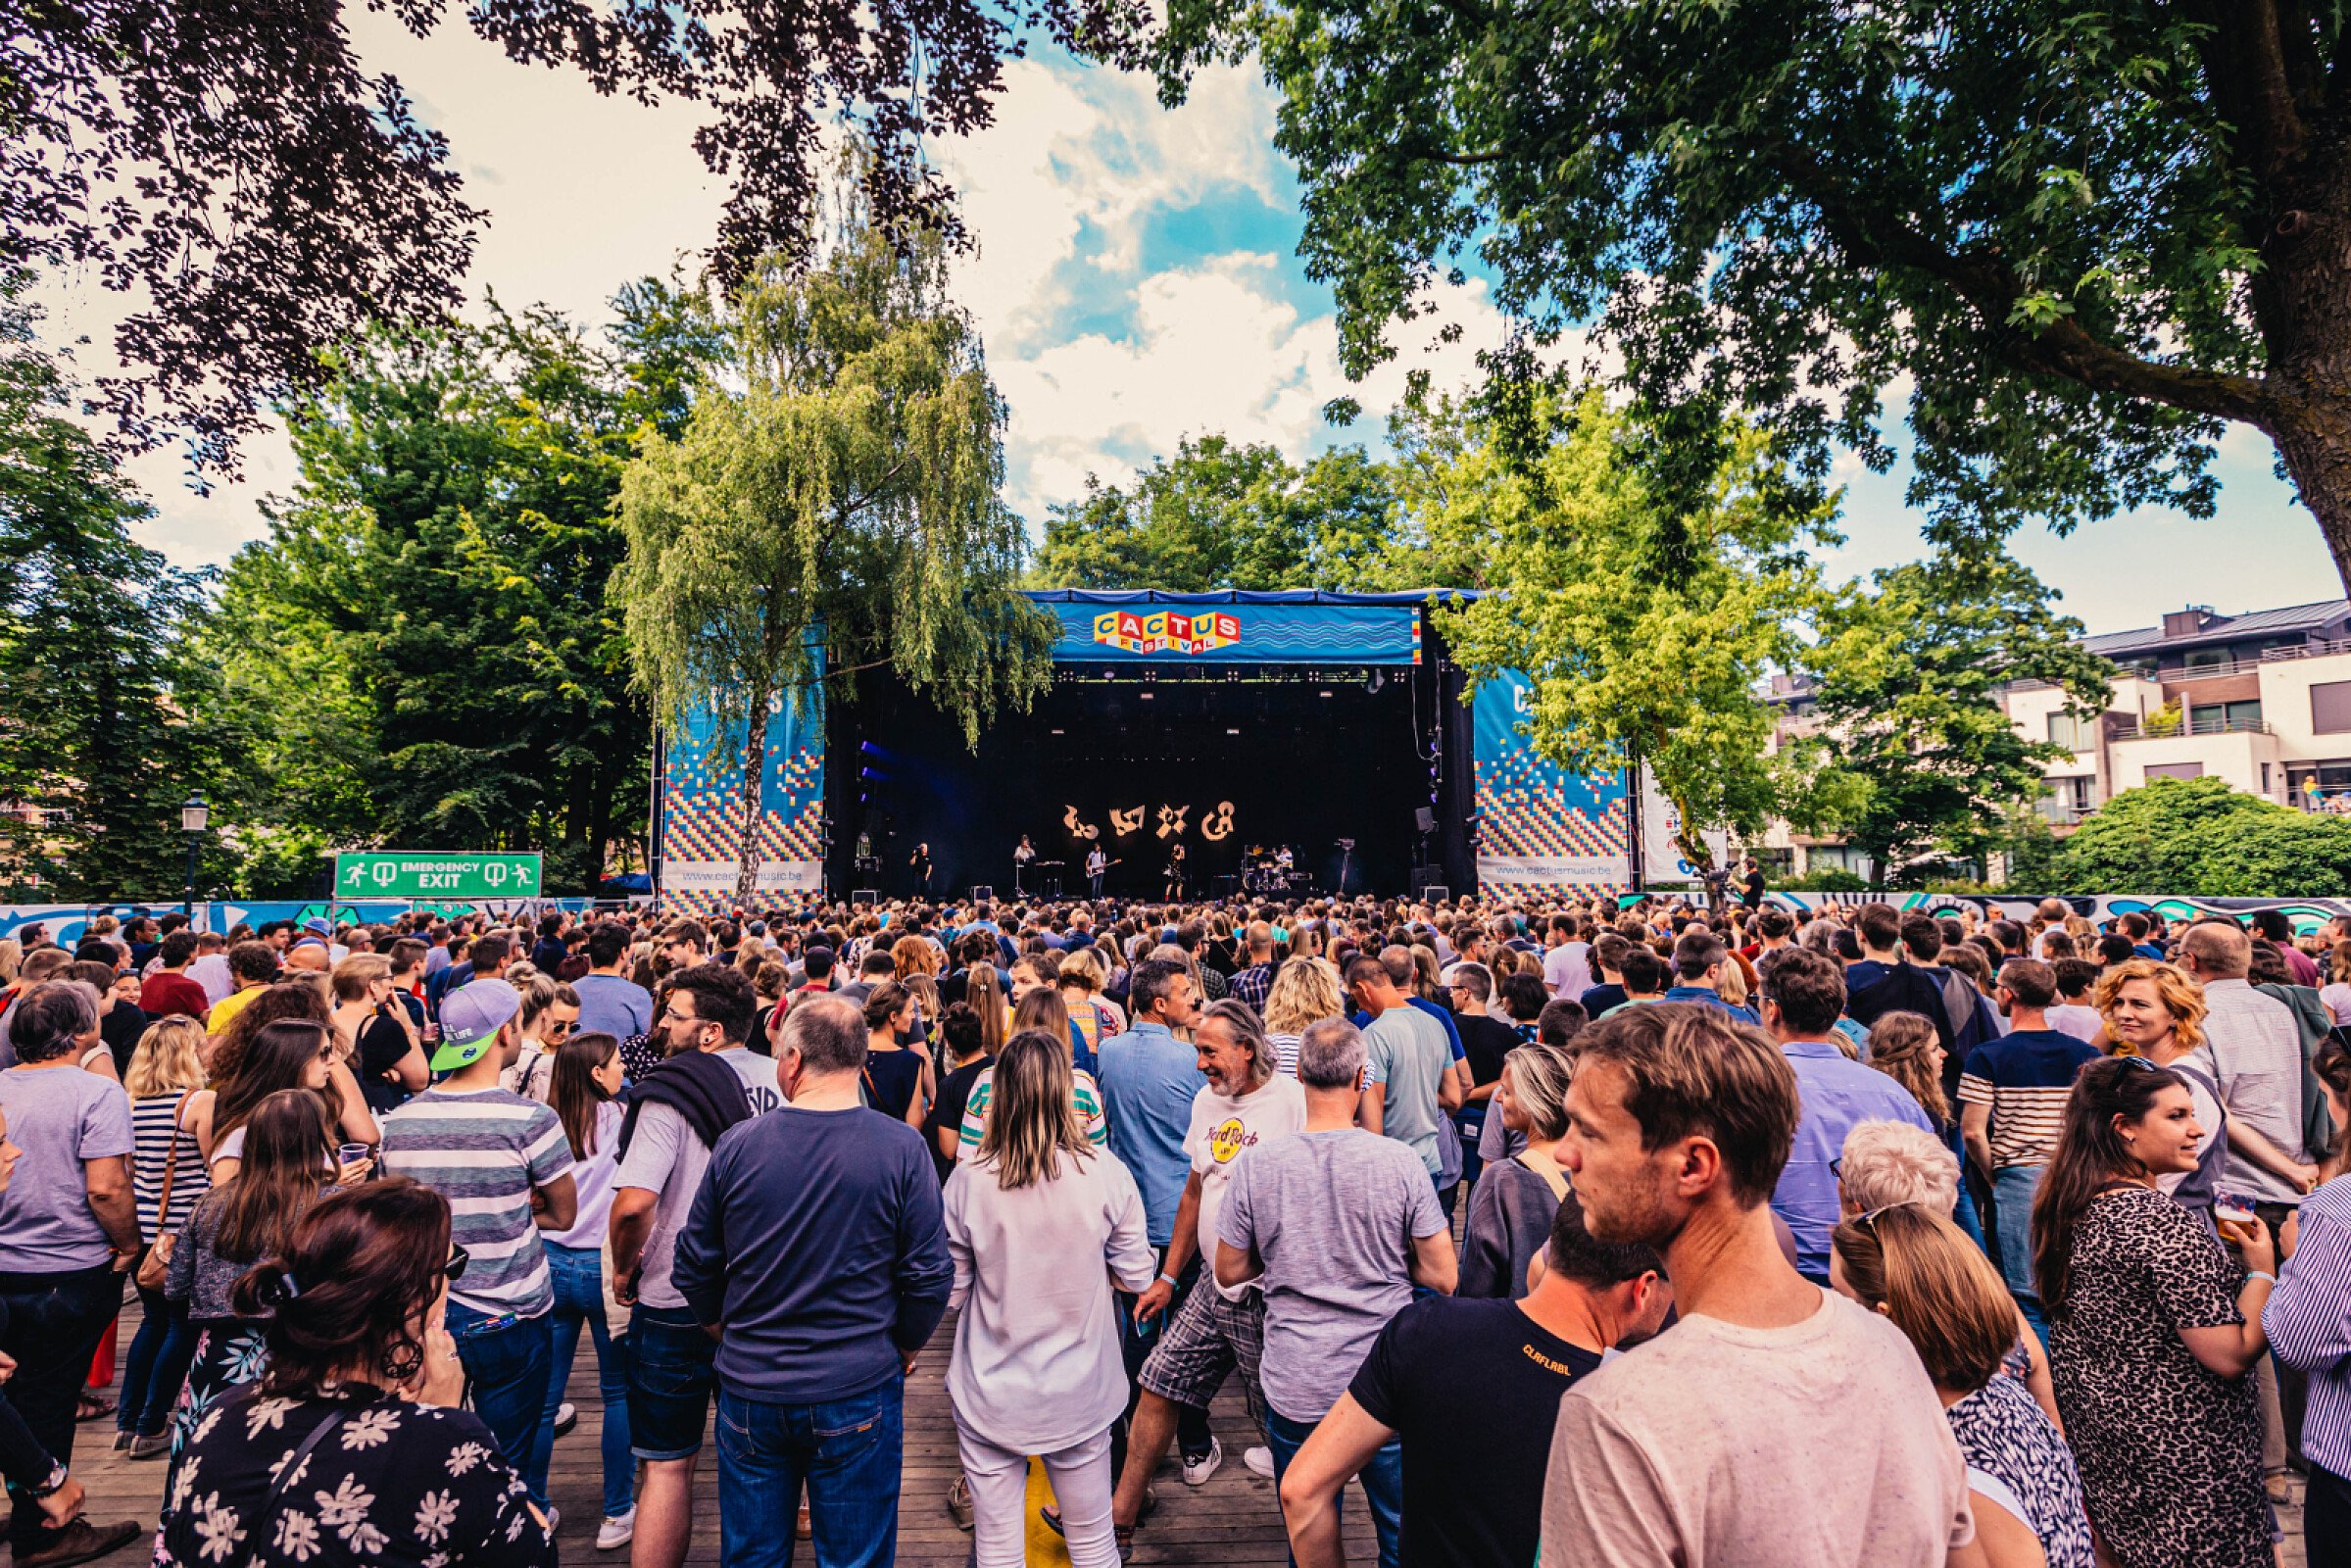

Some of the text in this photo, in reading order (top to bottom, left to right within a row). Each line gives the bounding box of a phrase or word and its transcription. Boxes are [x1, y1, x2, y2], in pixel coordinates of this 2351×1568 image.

[1098, 617, 1237, 635] CACTUS
[1120, 638, 1214, 652] FESTIVAL
[401, 861, 479, 872] EMERGENCY
[418, 873, 461, 888] EXIT
[682, 870, 802, 881] www.cactmusic.be
